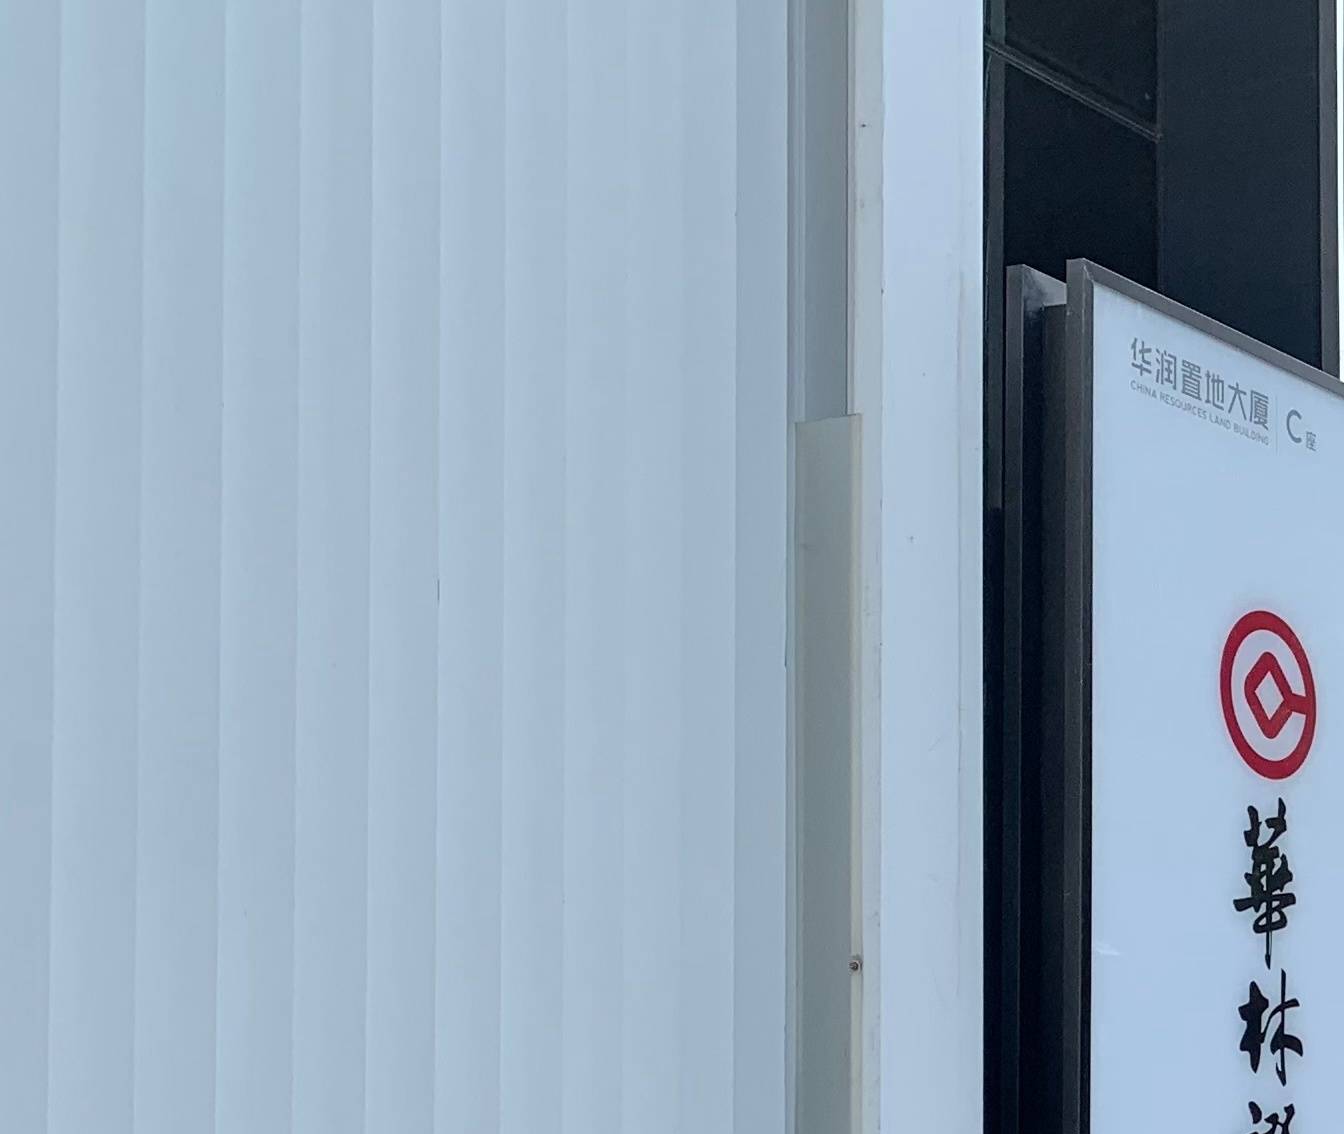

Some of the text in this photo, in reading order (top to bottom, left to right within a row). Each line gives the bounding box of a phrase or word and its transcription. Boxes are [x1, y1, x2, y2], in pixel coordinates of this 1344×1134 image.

[1130, 337, 1269, 431] 华润置地大厦
[1130, 379, 1269, 446] CHINA RESOURCES LAND BUILDING
